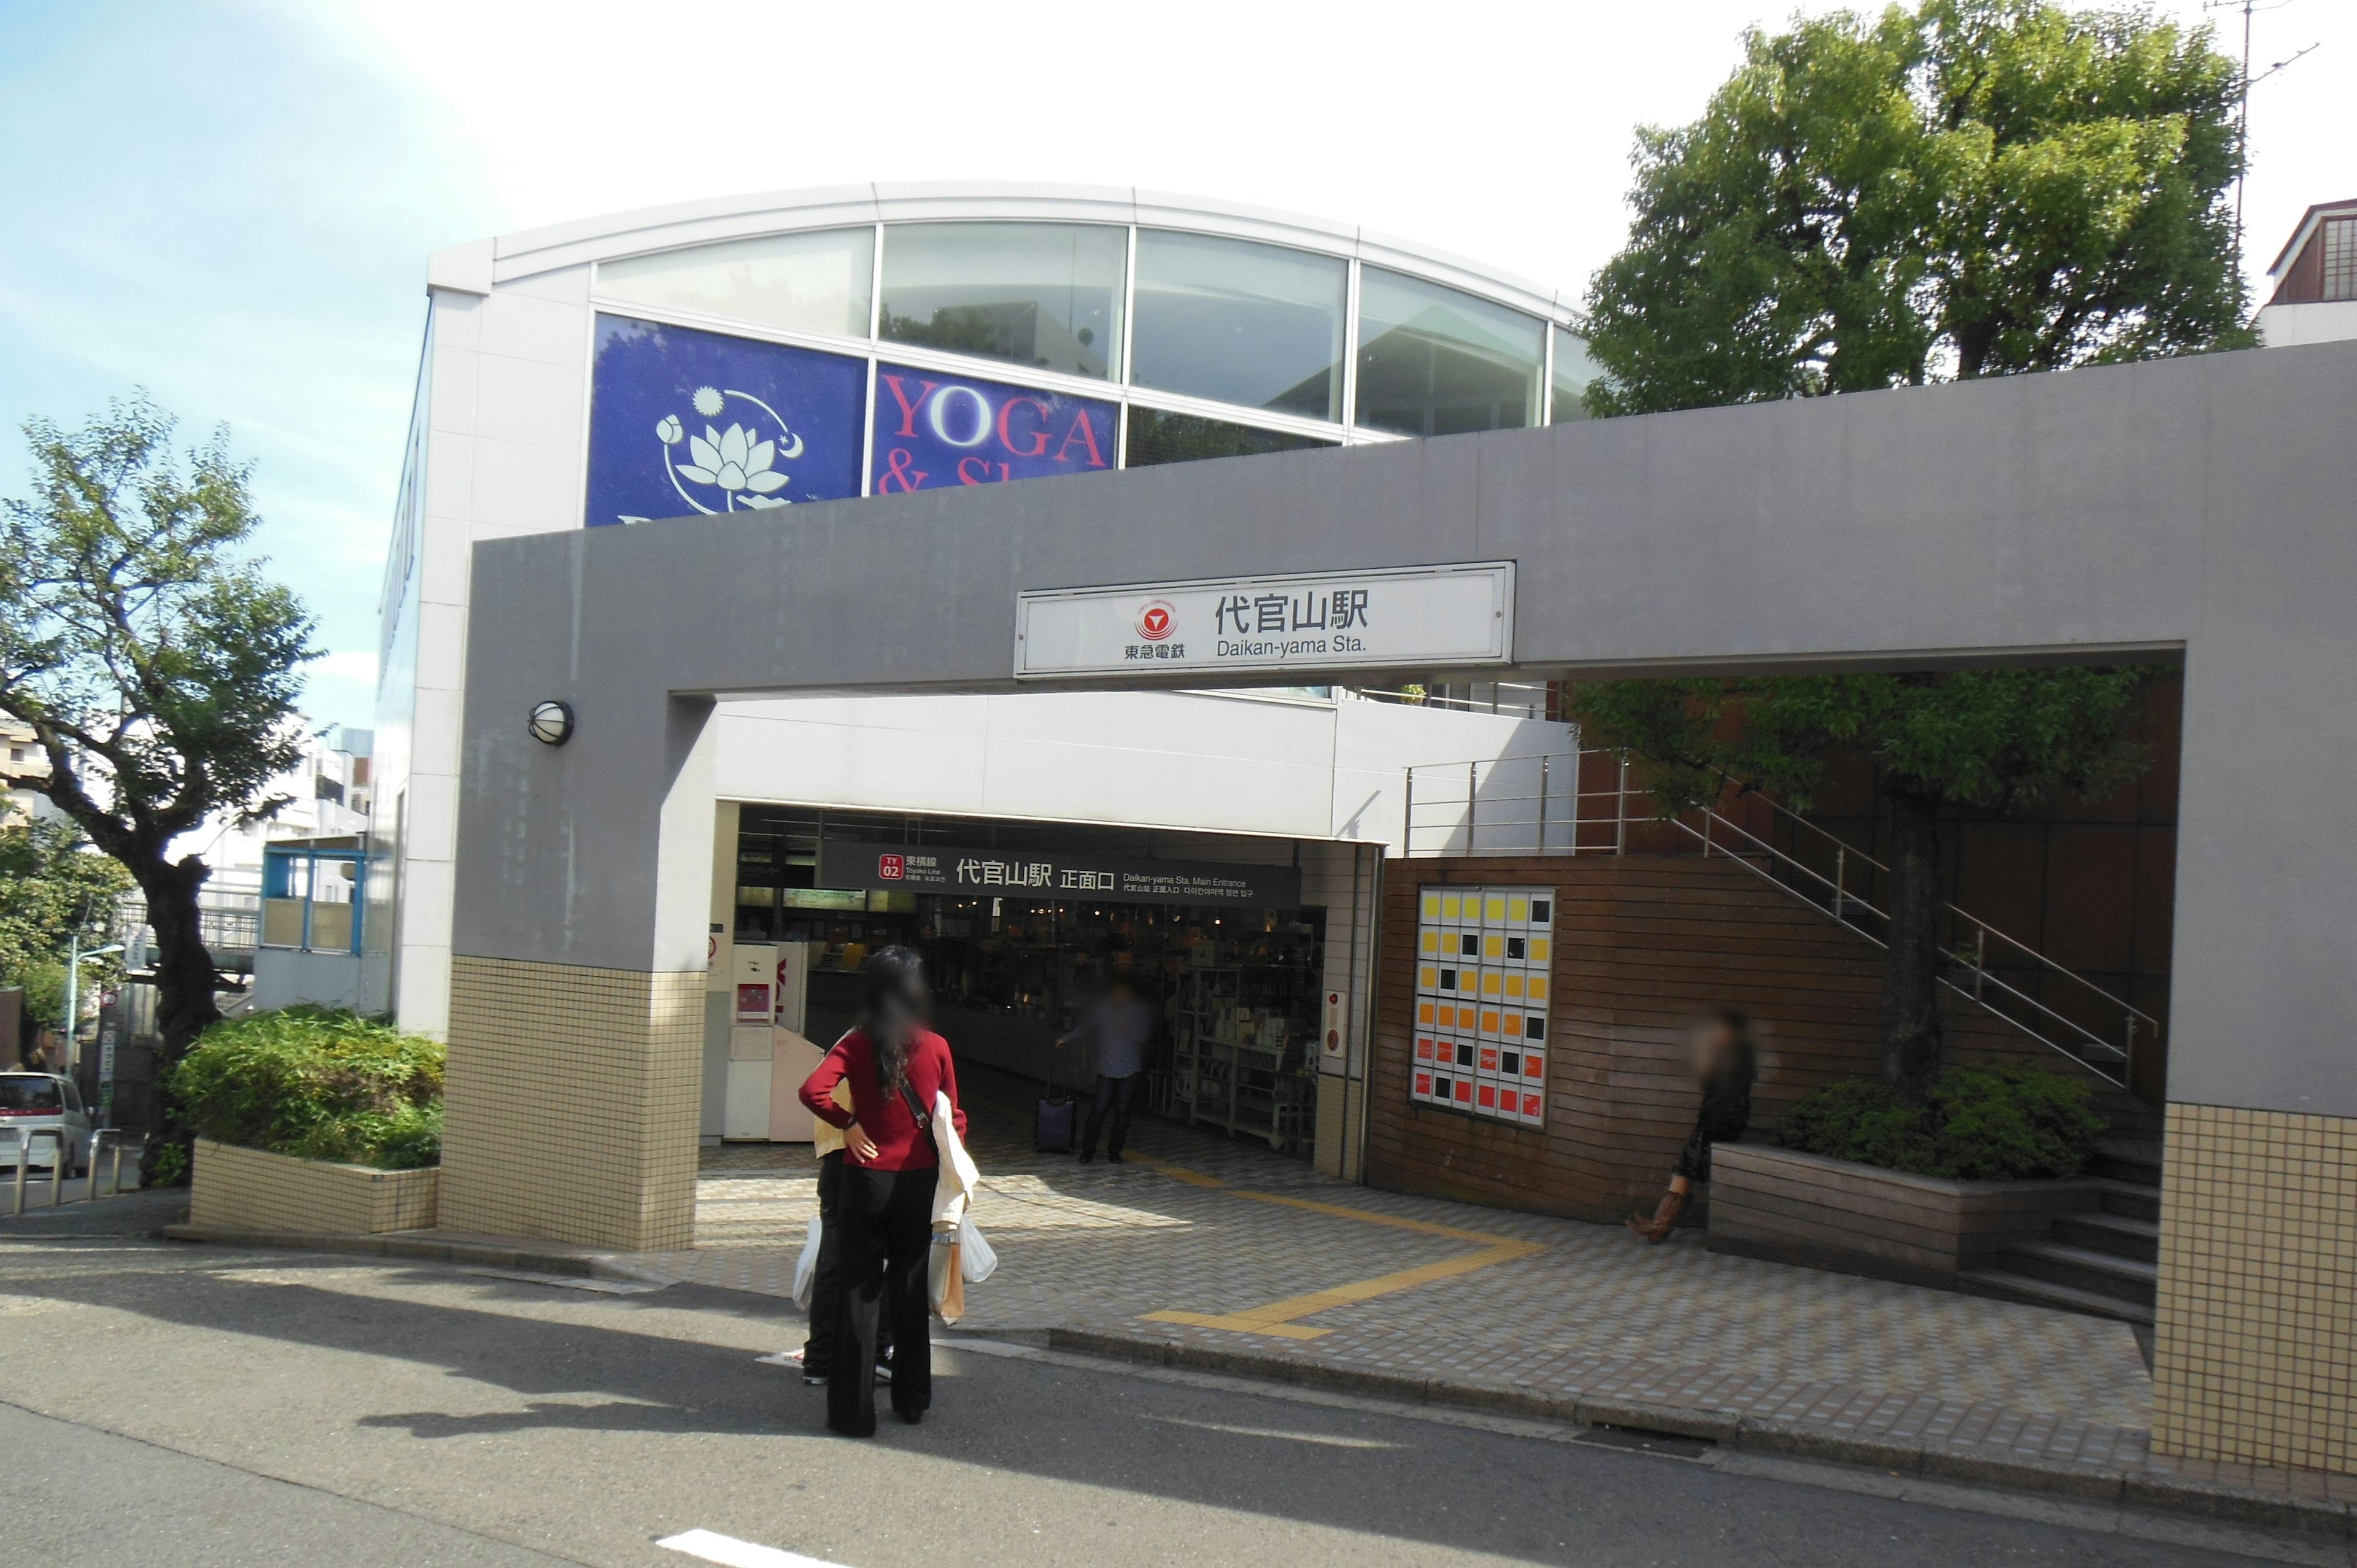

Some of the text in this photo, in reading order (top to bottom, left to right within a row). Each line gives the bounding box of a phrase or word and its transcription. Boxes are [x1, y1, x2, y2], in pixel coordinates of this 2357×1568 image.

[881, 374, 1107, 468] YOGA
[878, 447, 929, 496] &
[1215, 589, 1369, 636] 代官山駅
[1124, 643, 1185, 660] 東急電鉄
[1217, 635, 1367, 657] Daikan-yama Sta.
[883, 866, 899, 876] 02
[905, 856, 937, 867] 東横線
[956, 858, 1114, 890] 代官山駅 正面口
[1123, 873, 1246, 887] Daikan-yama Sta. Main Entrance
[1480, 1053, 1496, 1064] Sign
